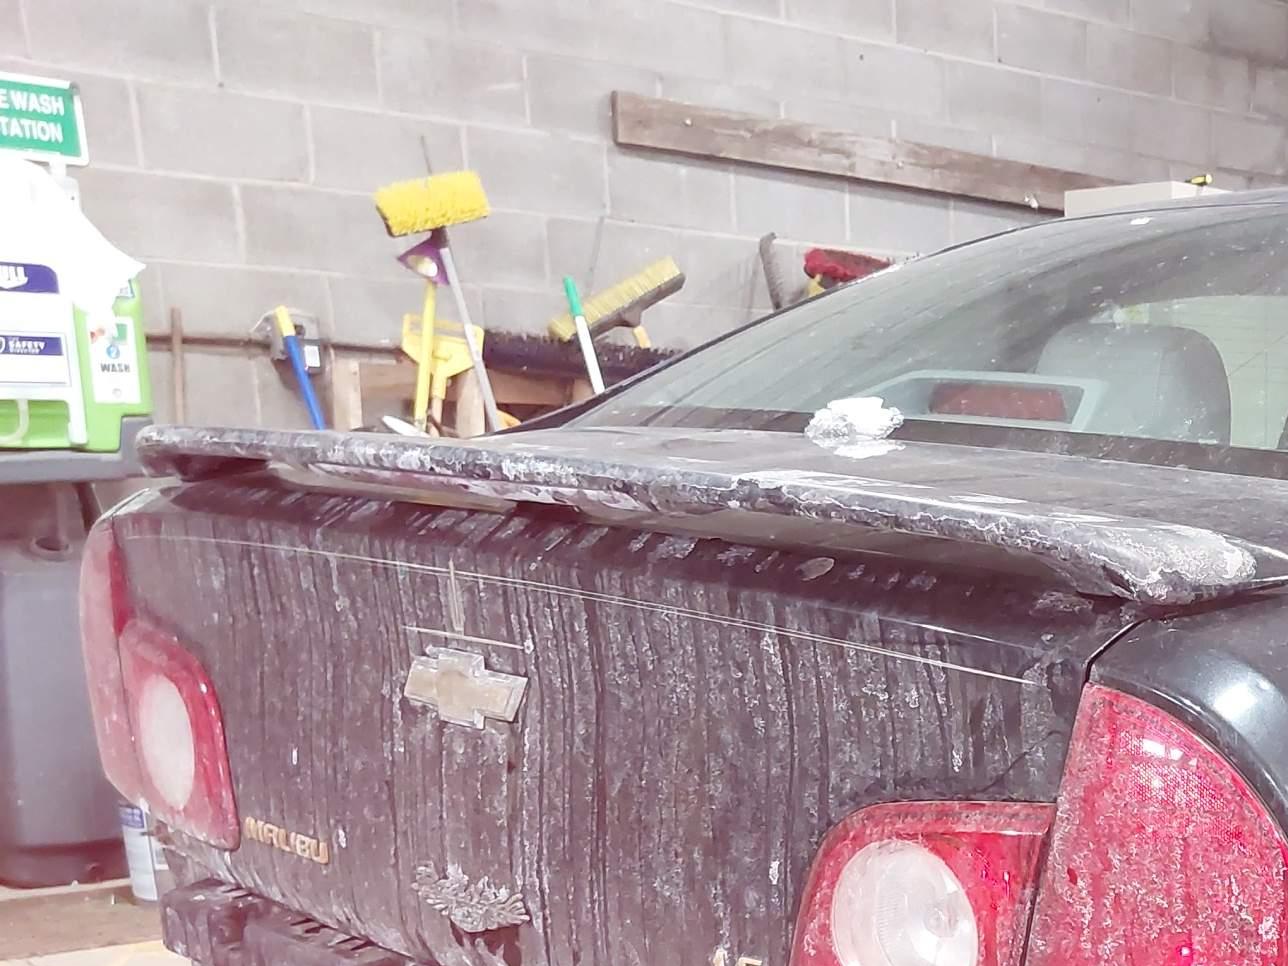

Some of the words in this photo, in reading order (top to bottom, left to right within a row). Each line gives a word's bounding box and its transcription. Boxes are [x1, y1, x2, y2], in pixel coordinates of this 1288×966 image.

[10, 90, 65, 117] WASH
[100, 363, 131, 373] WASH
[244, 816, 329, 865] MALIBU
